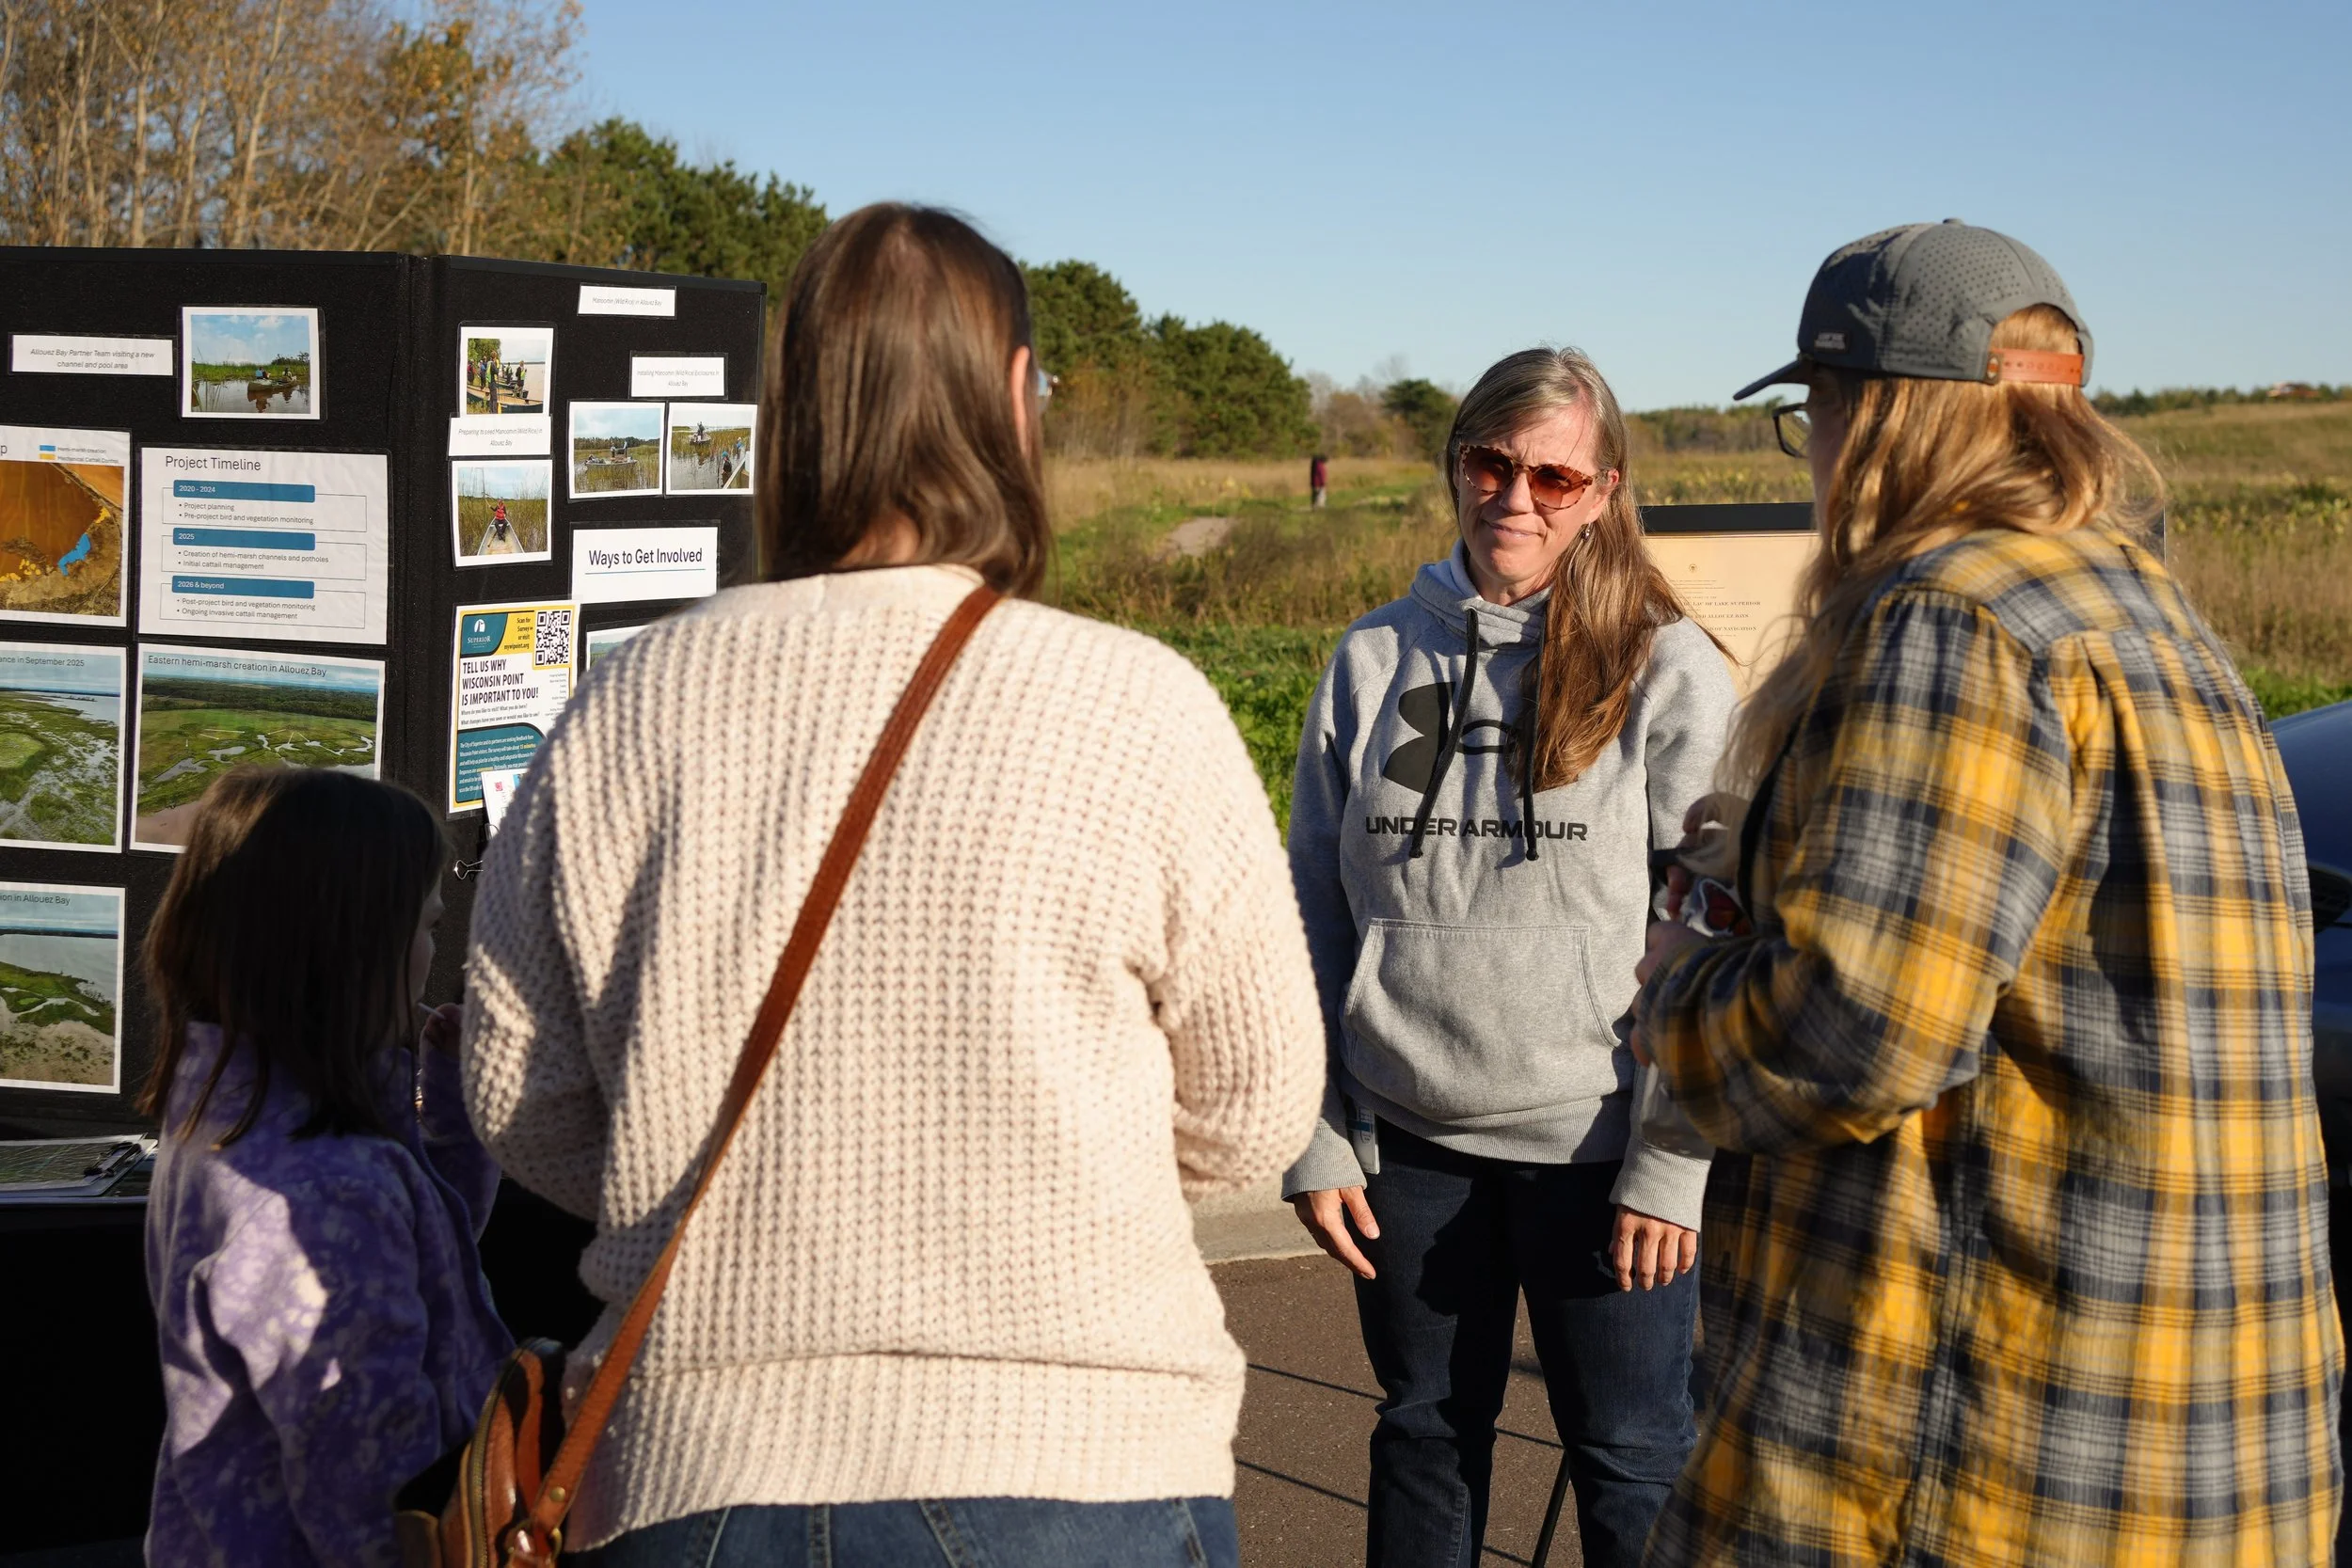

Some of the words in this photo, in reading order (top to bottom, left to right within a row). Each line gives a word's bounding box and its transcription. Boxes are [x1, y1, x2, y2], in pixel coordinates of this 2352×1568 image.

[56, 349, 68, 357] Bay
[112, 350, 135, 359] visiting
[166, 455, 208, 470] Project
[211, 457, 262, 470] Timeline
[183, 502, 207, 511] Project
[207, 503, 235, 512] planning
[183, 512, 218, 521] Pre-project
[219, 513, 232, 521] bird
[246, 515, 278, 523] vegetation
[279, 516, 314, 525] monitoring
[219, 551, 257, 560] hemi-marsh
[301, 555, 329, 563] potholes
[589, 549, 620, 569] Ways
[622, 550, 633, 564] to
[635, 548, 654, 564] Get
[657, 547, 702, 563] Involved
[200, 581, 225, 590] beyond
[182, 598, 220, 607] Post-project
[248, 600, 280, 610] vegetation
[281, 602, 316, 611] monitoring
[182, 608, 208, 617] Ongoing
[256, 611, 297, 620] management
[24, 657, 65, 666] September
[66, 658, 85, 667] 2025
[148, 655, 180, 665] Eastern
[182, 657, 231, 670] hemi-marsh
[233, 661, 268, 672] creation
[269, 663, 278, 673] in
[278, 664, 310, 675] Allouez
[310, 668, 326, 677] Bay
[463, 661, 478, 674] TELL
[480, 660, 489, 673] US
[490, 658, 507, 672] WHY
[462, 674, 501, 690] WISCONSIN
[502, 673, 524, 686] POINT
[461, 694, 469, 706] IS
[469, 689, 511, 705] IMPORTANT
[512, 689, 521, 700] TO
[522, 687, 539, 700] YOU!
[1366, 816, 1458, 837] UNDER
[23, 895, 54, 903] Allouez
[55, 895, 71, 907] Bay
